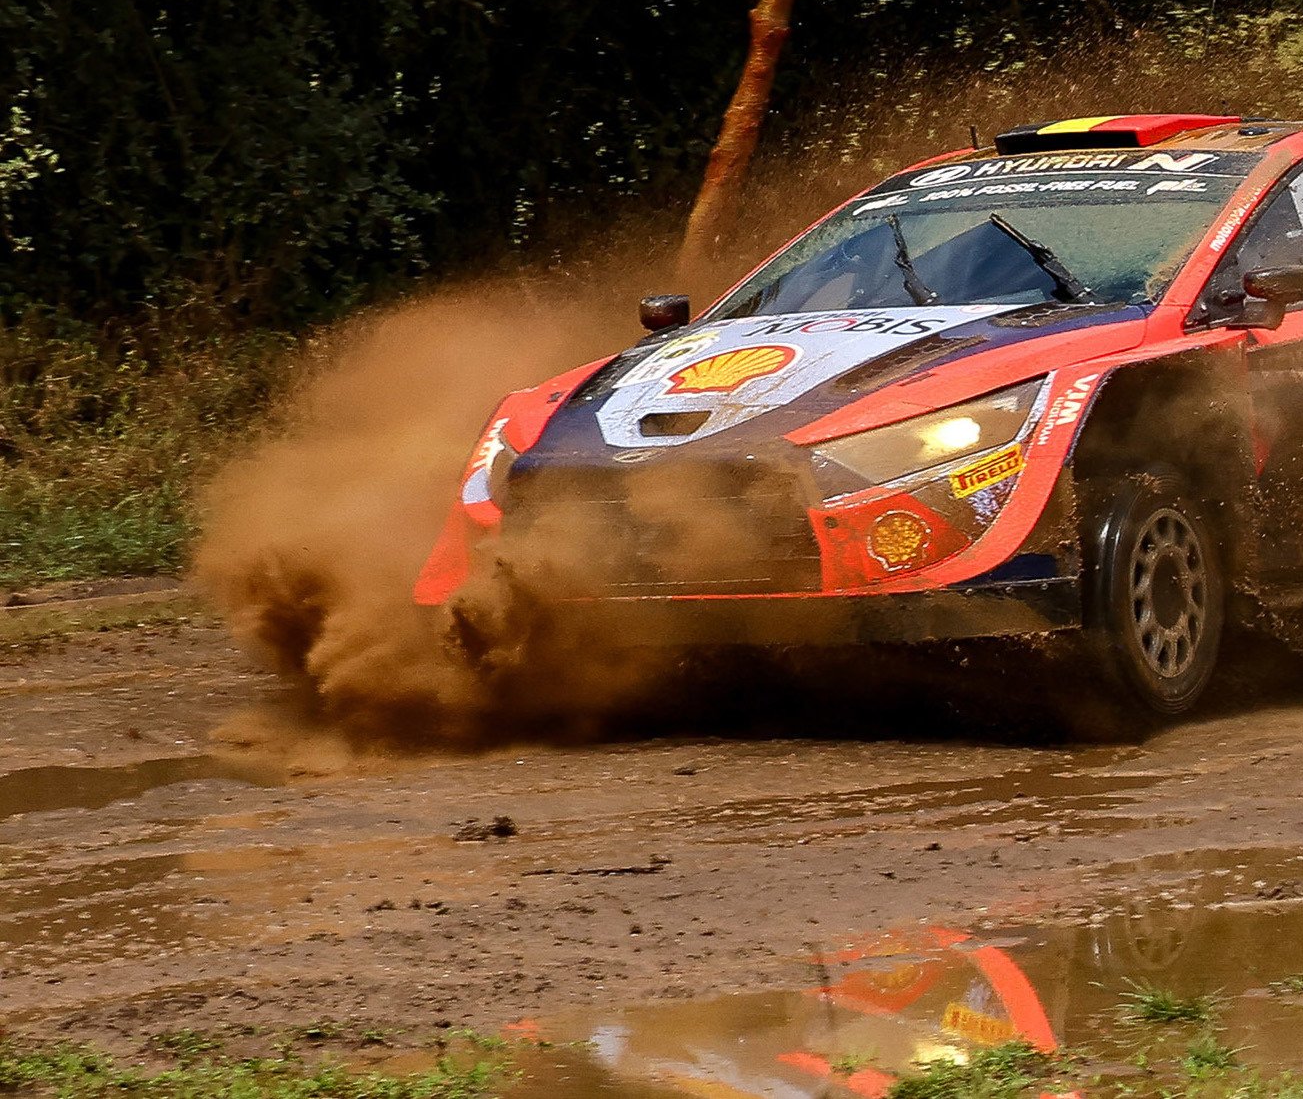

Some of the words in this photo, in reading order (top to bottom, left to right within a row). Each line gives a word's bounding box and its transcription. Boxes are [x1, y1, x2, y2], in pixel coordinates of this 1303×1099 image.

[973, 154, 1128, 177] HYUNDAI
[1089, 180, 1140, 191] FUEL
[741, 317, 946, 337] MOBIS
[1037, 396, 1065, 446] HYUNDAI
[953, 450, 1020, 491] PIRELLI
